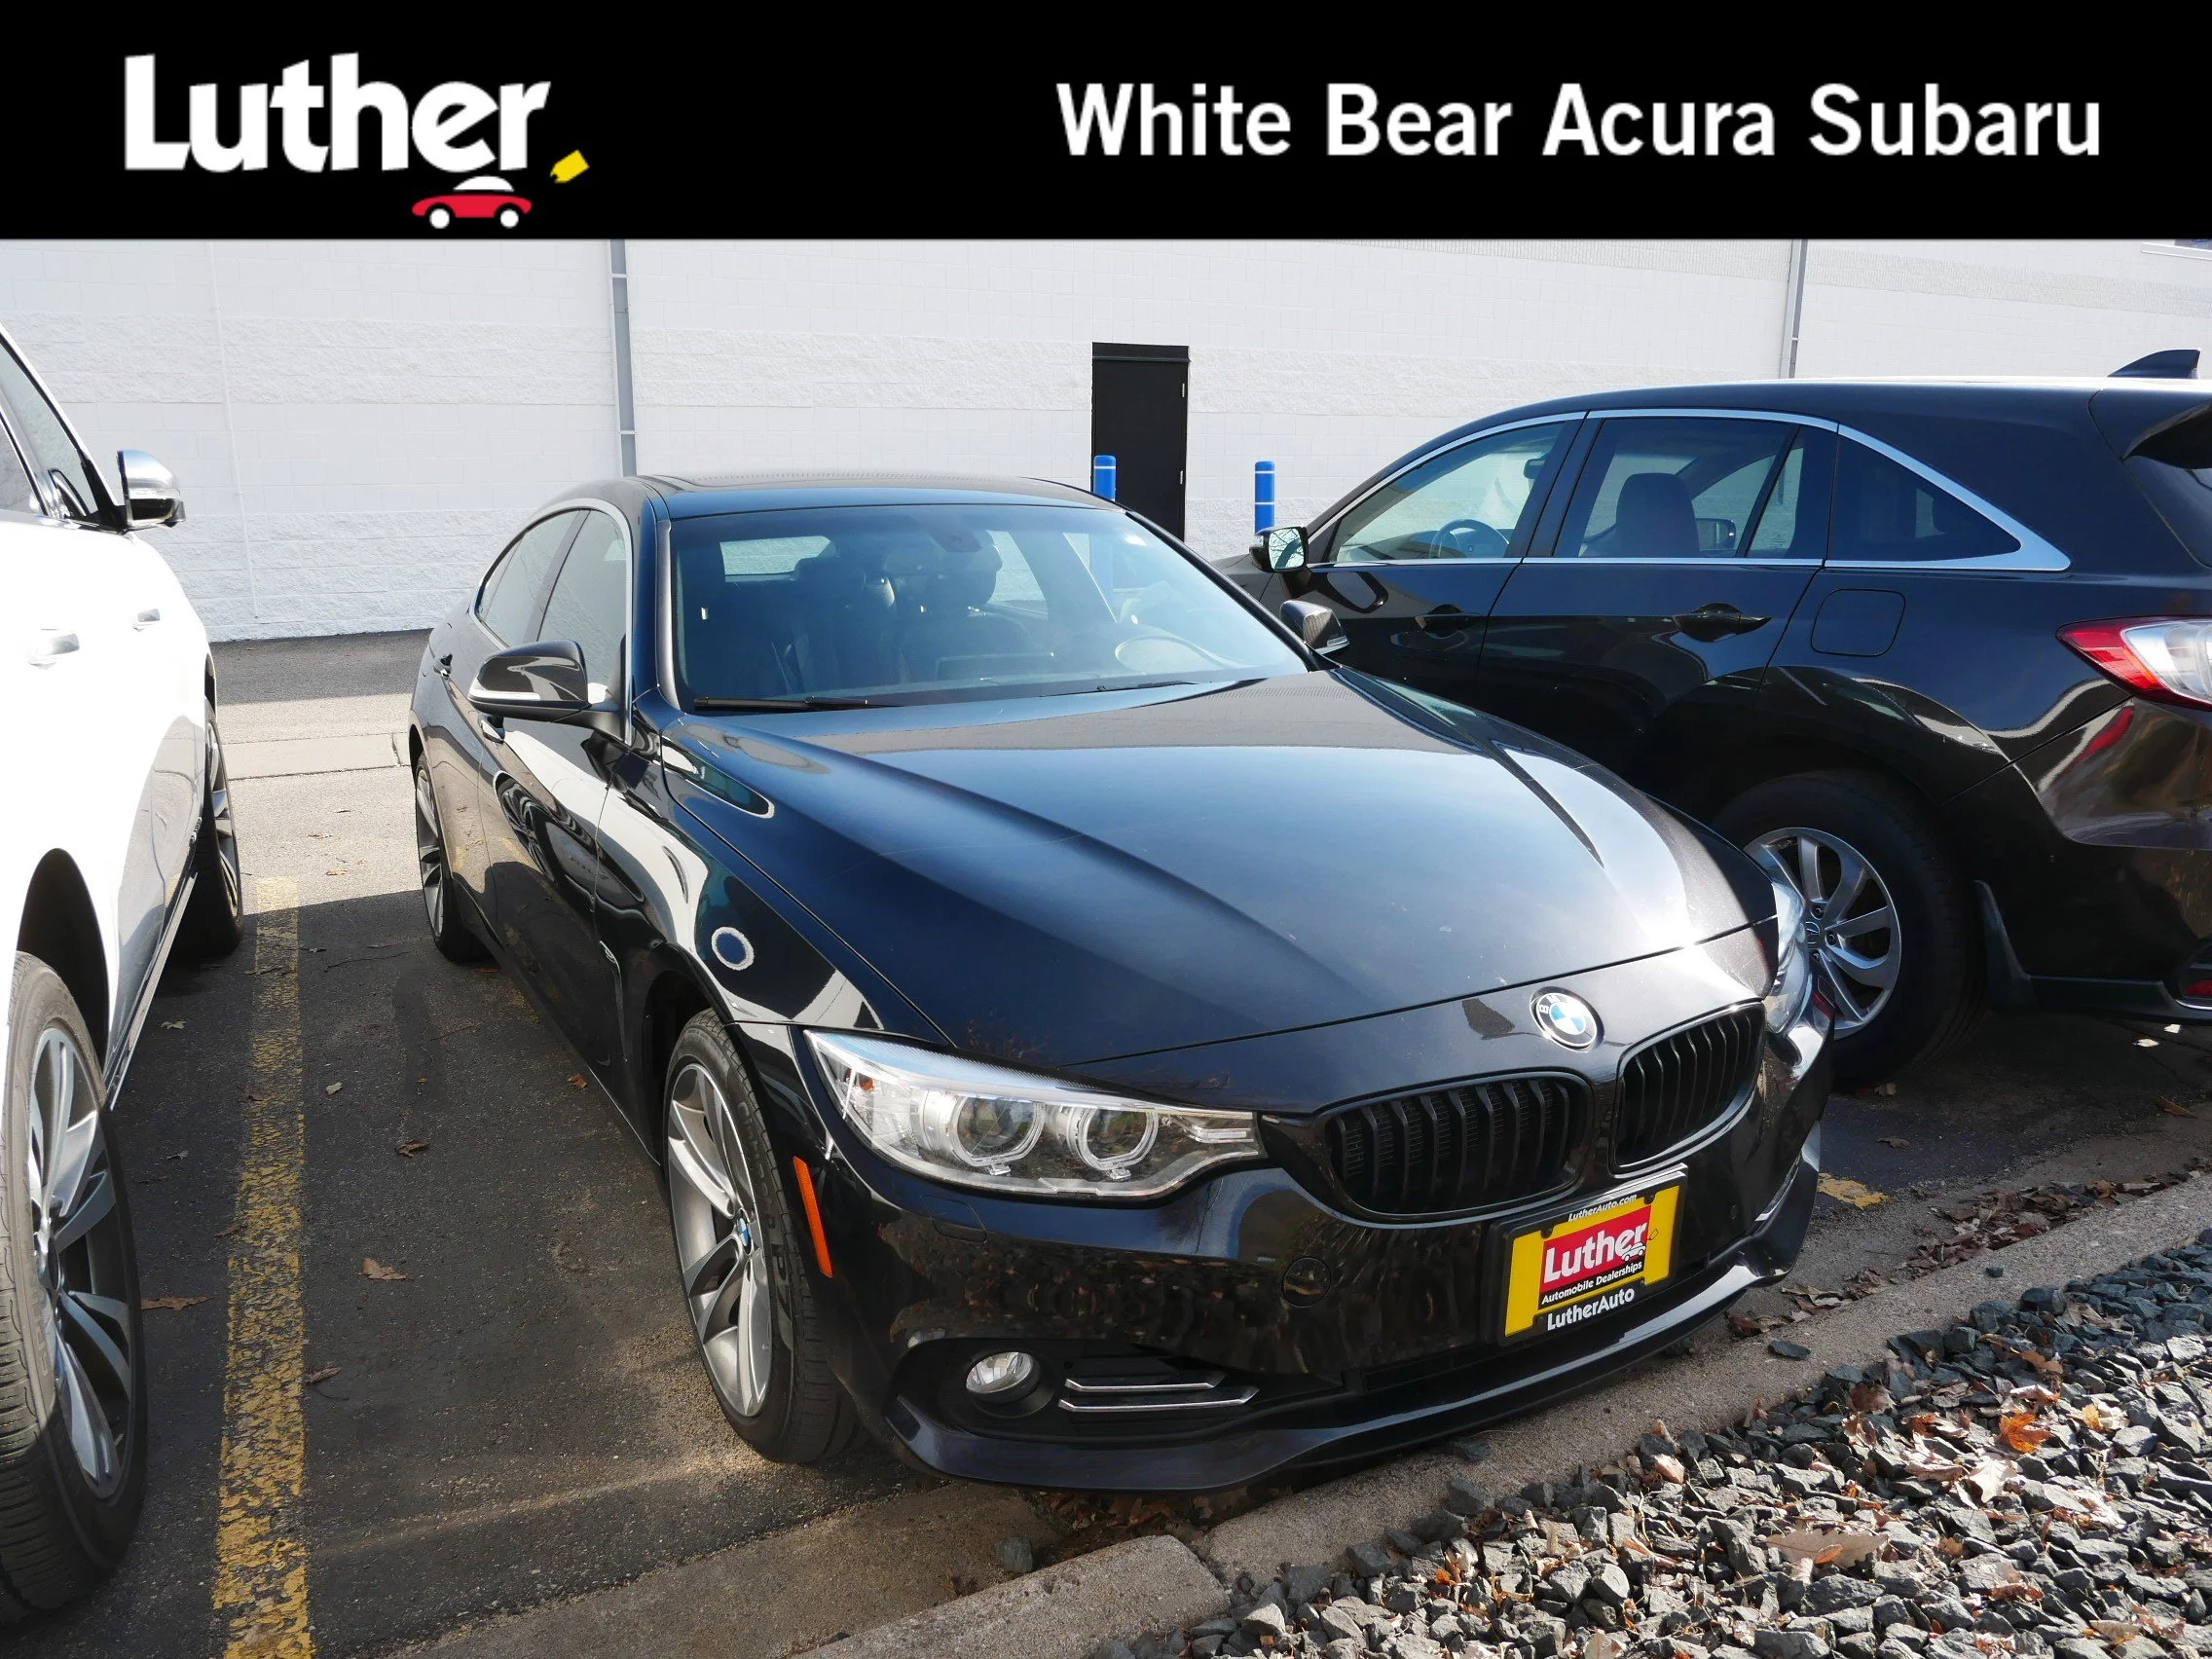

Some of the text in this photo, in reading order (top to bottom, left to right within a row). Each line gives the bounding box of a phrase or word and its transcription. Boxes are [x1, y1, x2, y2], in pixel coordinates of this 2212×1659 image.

[1567, 1194, 1637, 1222] LutherAuto.com
[1544, 1223, 1647, 1283] Luther
[1541, 1261, 1642, 1305] Automobile Dealerships
[1547, 1288, 1635, 1331] LutherAuto
